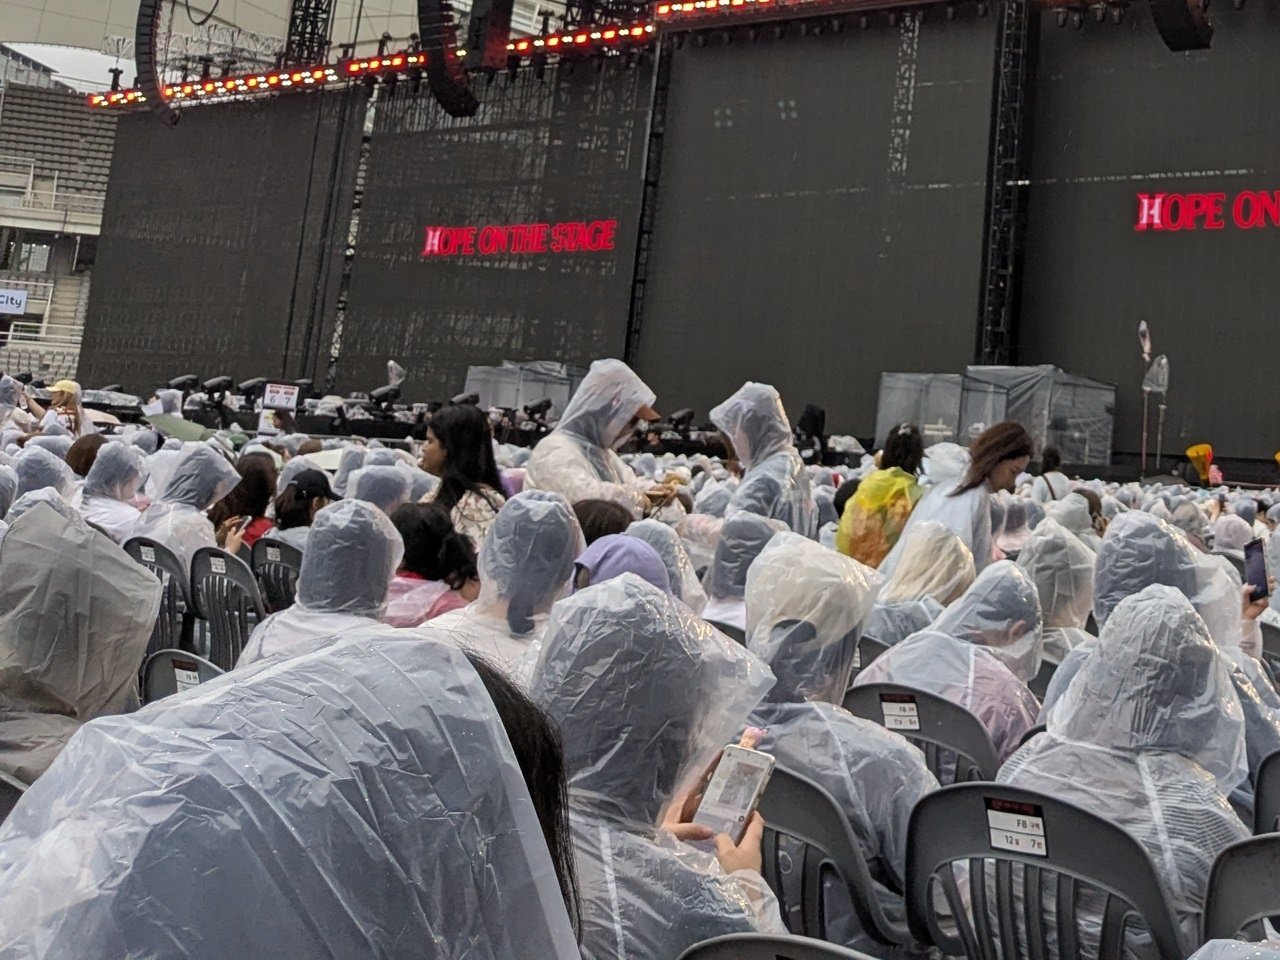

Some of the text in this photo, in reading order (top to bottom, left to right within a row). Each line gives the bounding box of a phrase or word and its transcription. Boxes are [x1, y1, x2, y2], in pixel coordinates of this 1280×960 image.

[1134, 192, 1225, 231] HOPE
[422, 220, 617, 257] HOPE ON THE STAGE
[1016, 818, 1027, 829] F8
